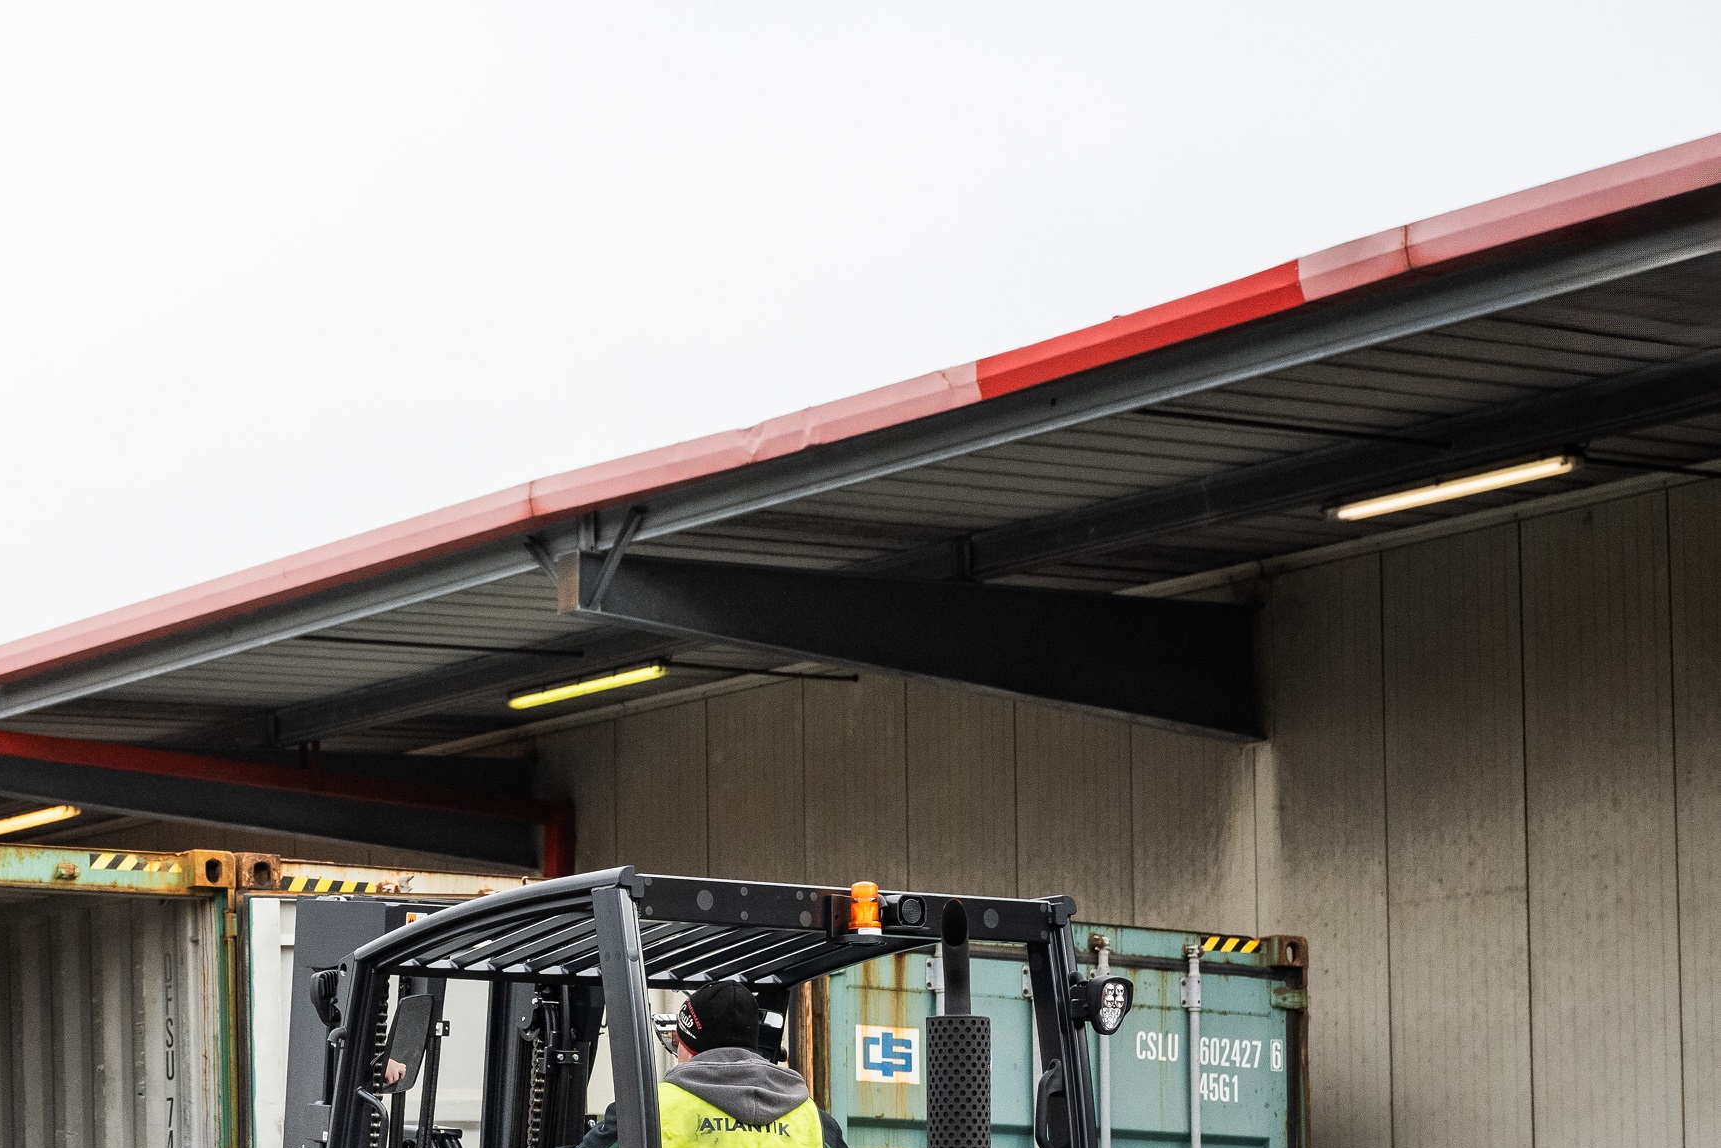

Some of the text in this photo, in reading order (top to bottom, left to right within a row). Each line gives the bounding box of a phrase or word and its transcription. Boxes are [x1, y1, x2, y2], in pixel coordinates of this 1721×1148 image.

[1136, 1031, 1282, 1070] CSLU 602427 6
[1200, 1073, 1239, 1102] 45G1
